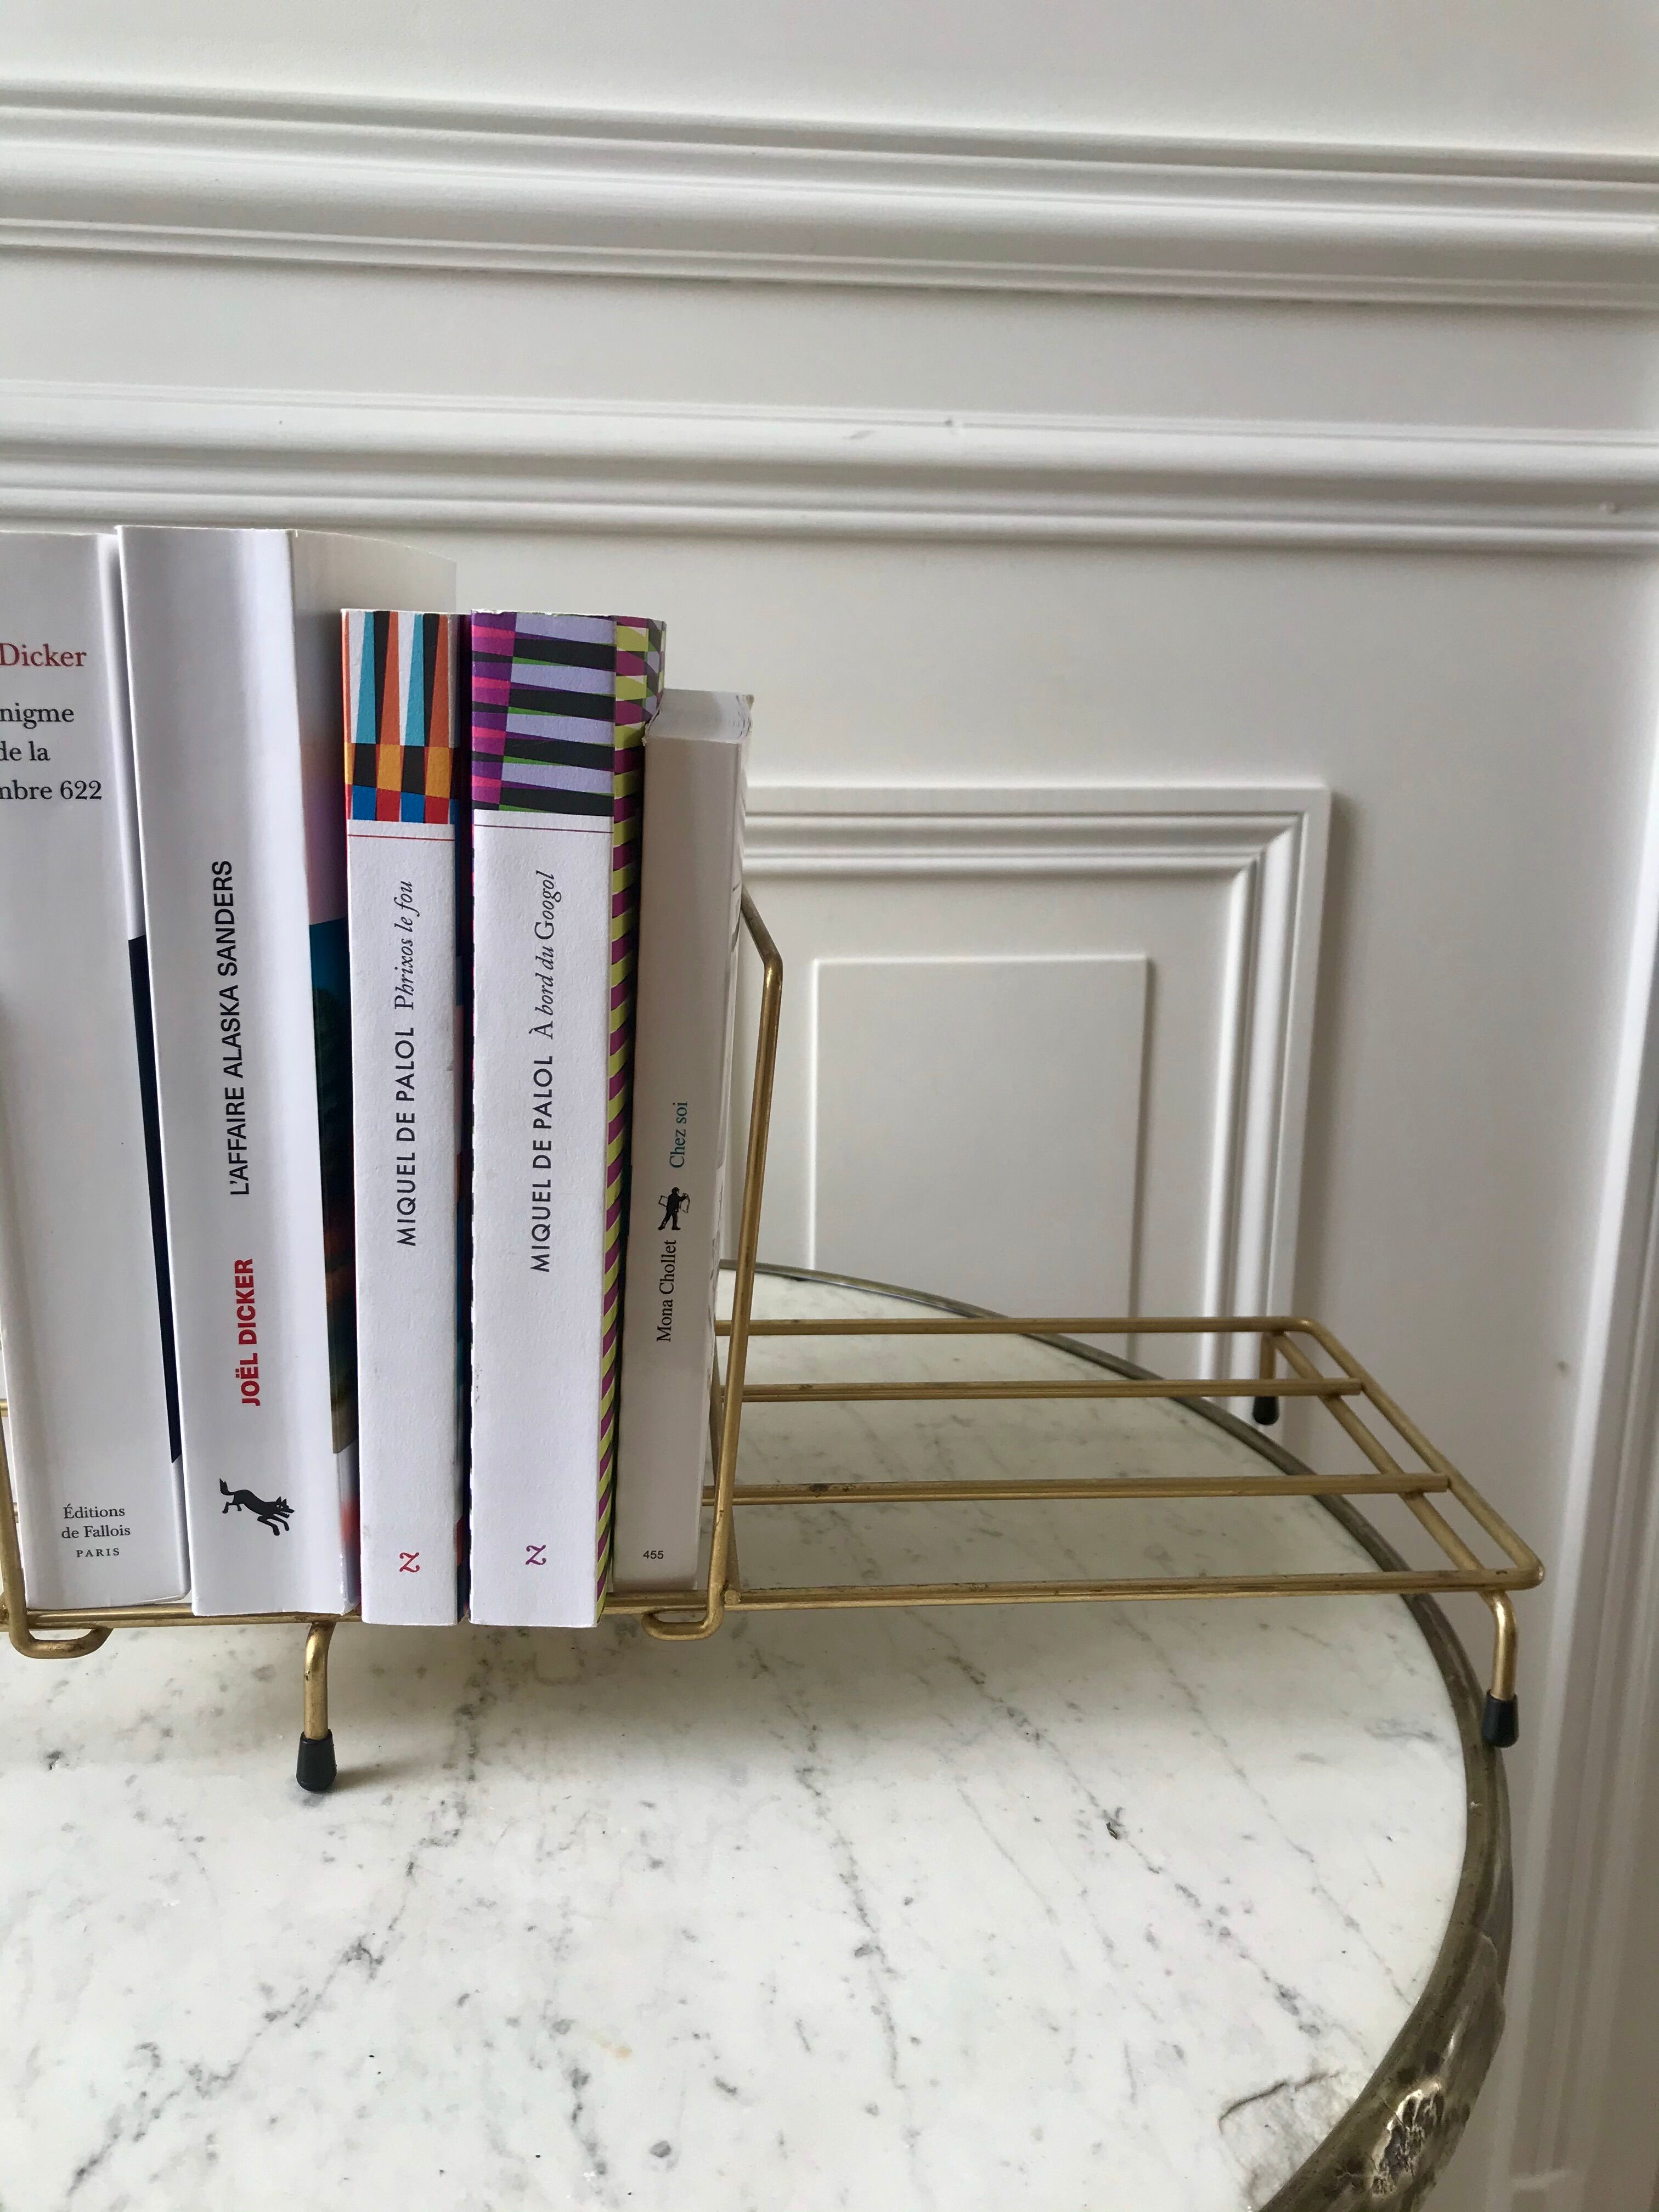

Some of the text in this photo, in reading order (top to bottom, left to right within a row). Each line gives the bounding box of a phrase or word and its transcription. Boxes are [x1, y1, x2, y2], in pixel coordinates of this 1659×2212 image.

[0, 642, 87, 667] Dicker
[0, 740, 51, 761] de la
[60, 780, 102, 800] 622
[211, 860, 238, 977] SANDERS
[219, 984, 244, 1079] ALASKA
[393, 881, 420, 1246] MIQUEL DE PALOL Phrixos le fou
[528, 870, 562, 1273] MIQUEL DE PALOL À bord du Googol
[669, 1102, 688, 1169] Chez soi
[656, 1239, 677, 1342] Mona Chollet
[234, 1259, 261, 1407] JOËL DICKER
[61, 1525, 131, 1539] de Fallois
[63, 1503, 125, 1519] Éditions
[76, 1548, 120, 1558] PARIS
[642, 1550, 664, 1560] 455
